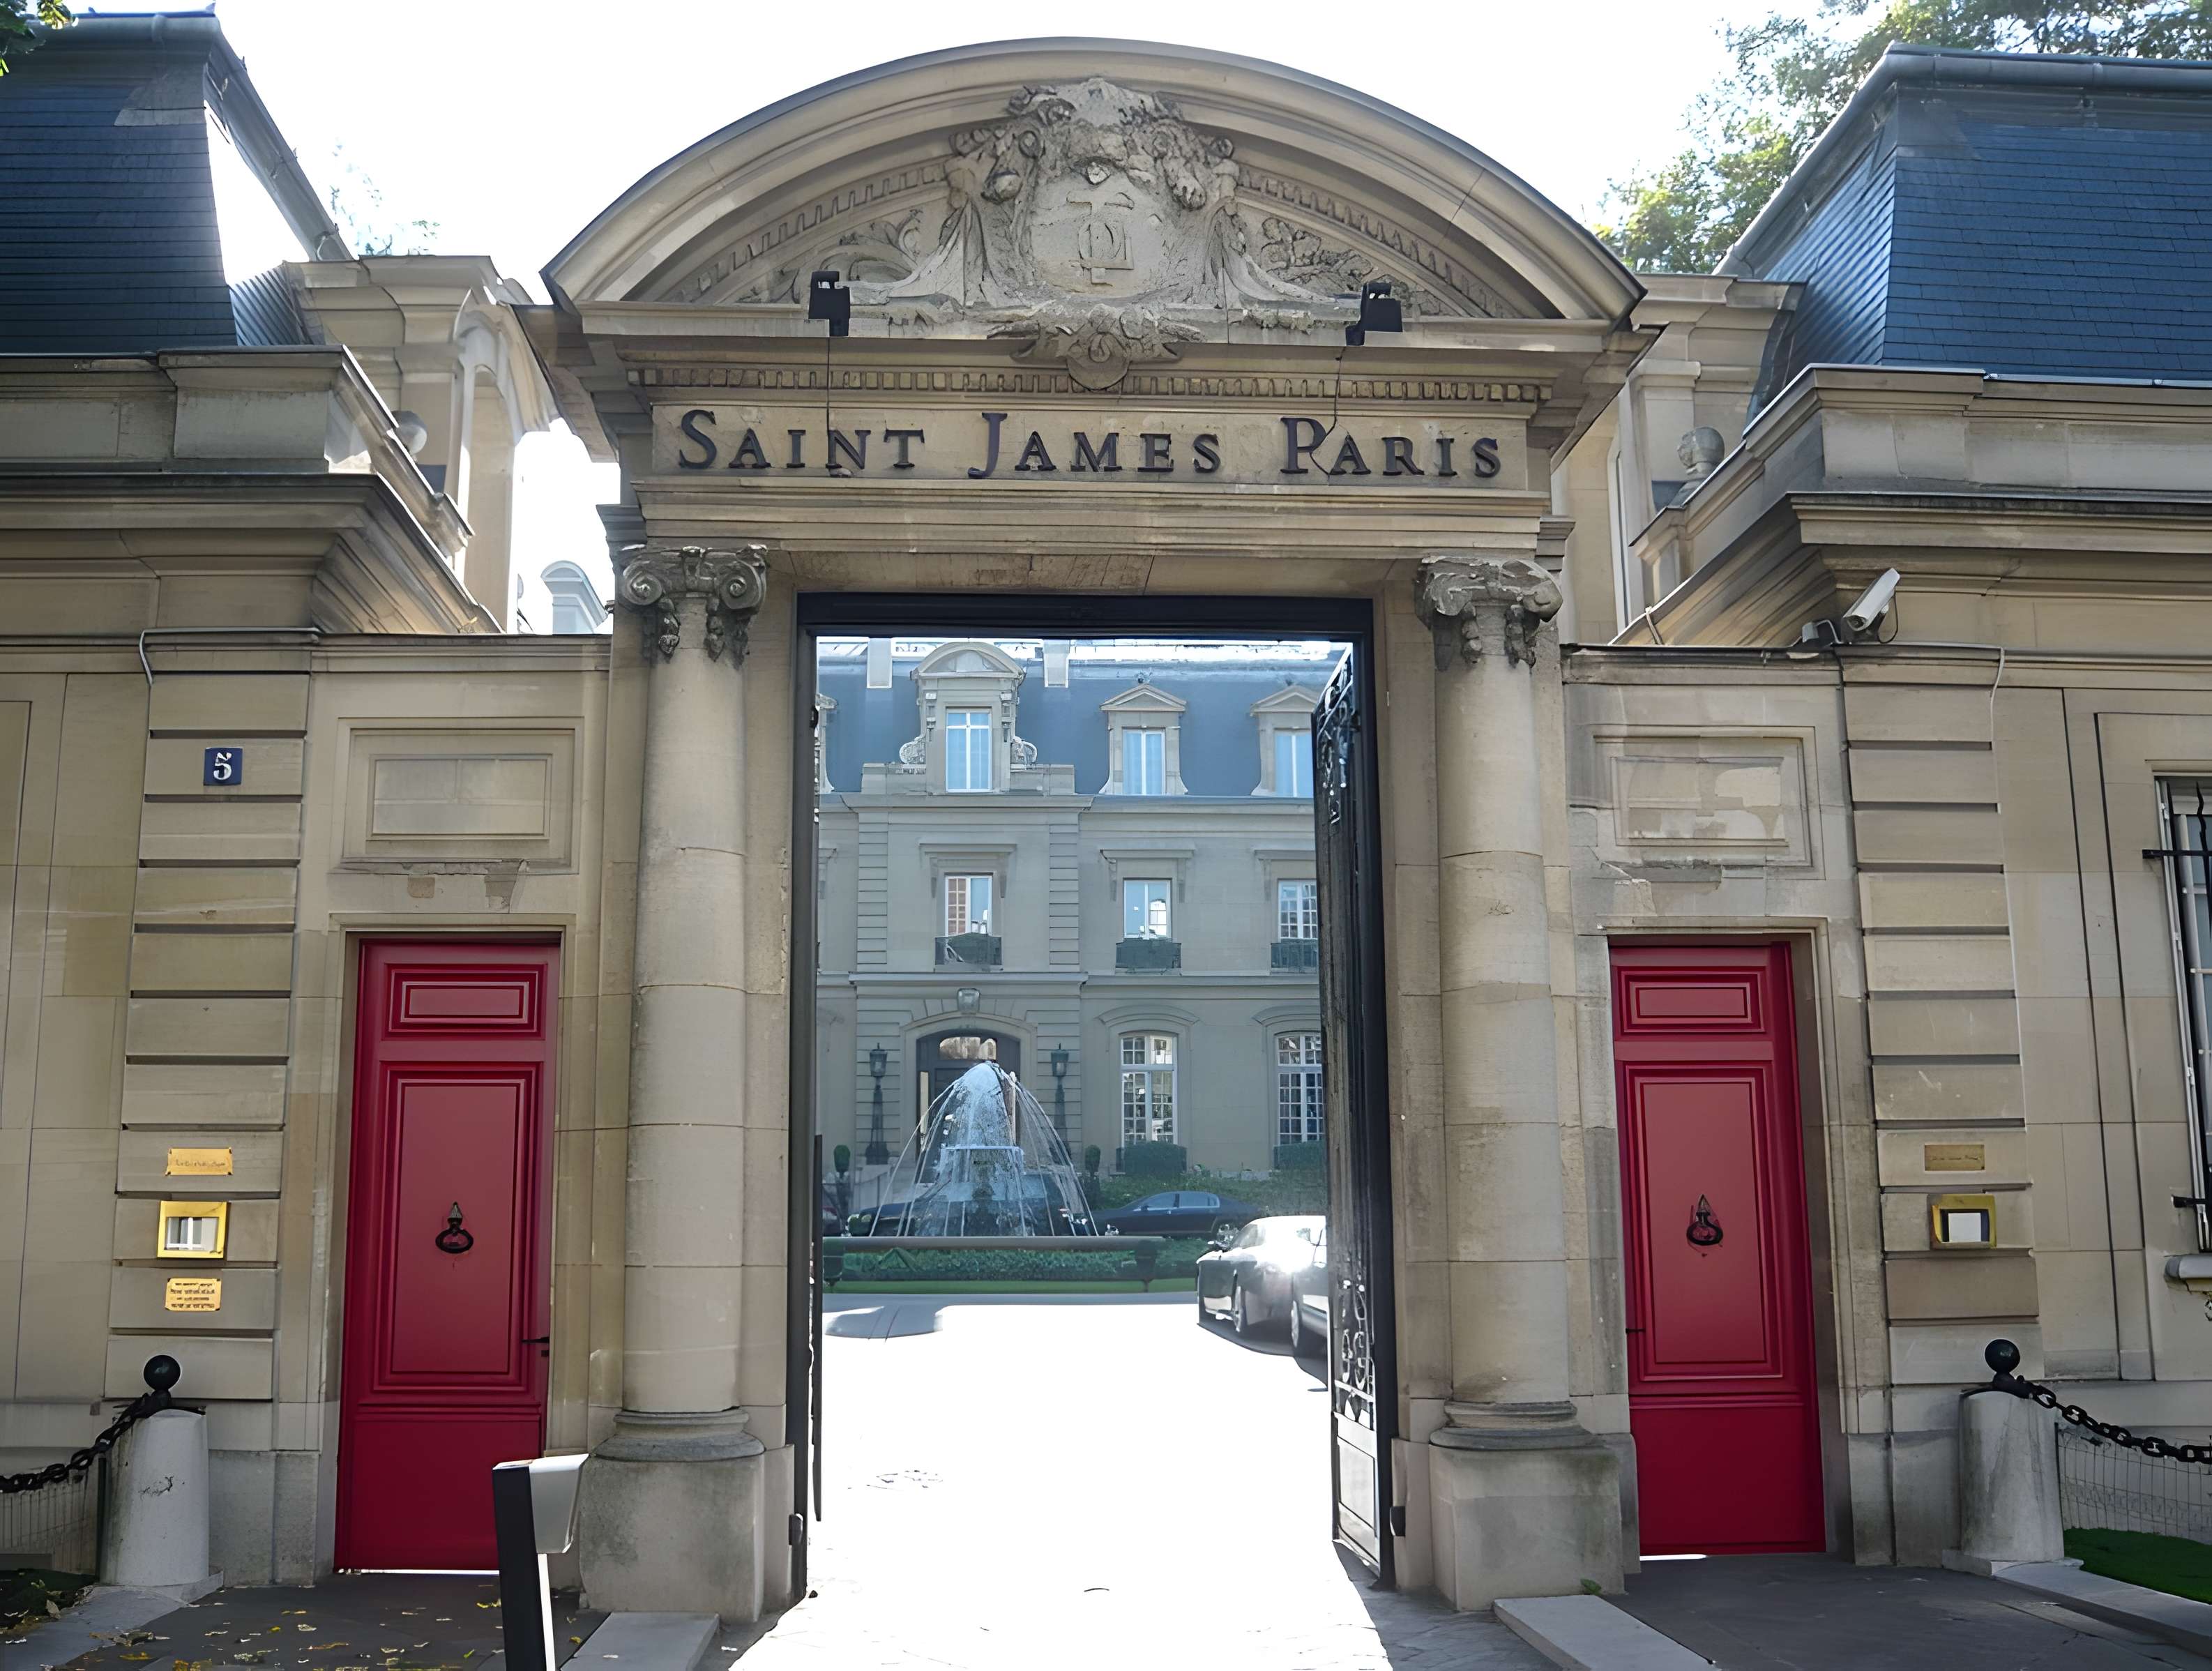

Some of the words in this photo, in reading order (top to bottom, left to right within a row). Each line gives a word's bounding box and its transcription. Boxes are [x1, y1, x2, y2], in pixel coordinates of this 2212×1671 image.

[679, 408, 926, 470] SAINT
[967, 411, 1222, 479] JAMES
[1279, 415, 1501, 478] PARIS
[213, 752, 232, 780] 5
